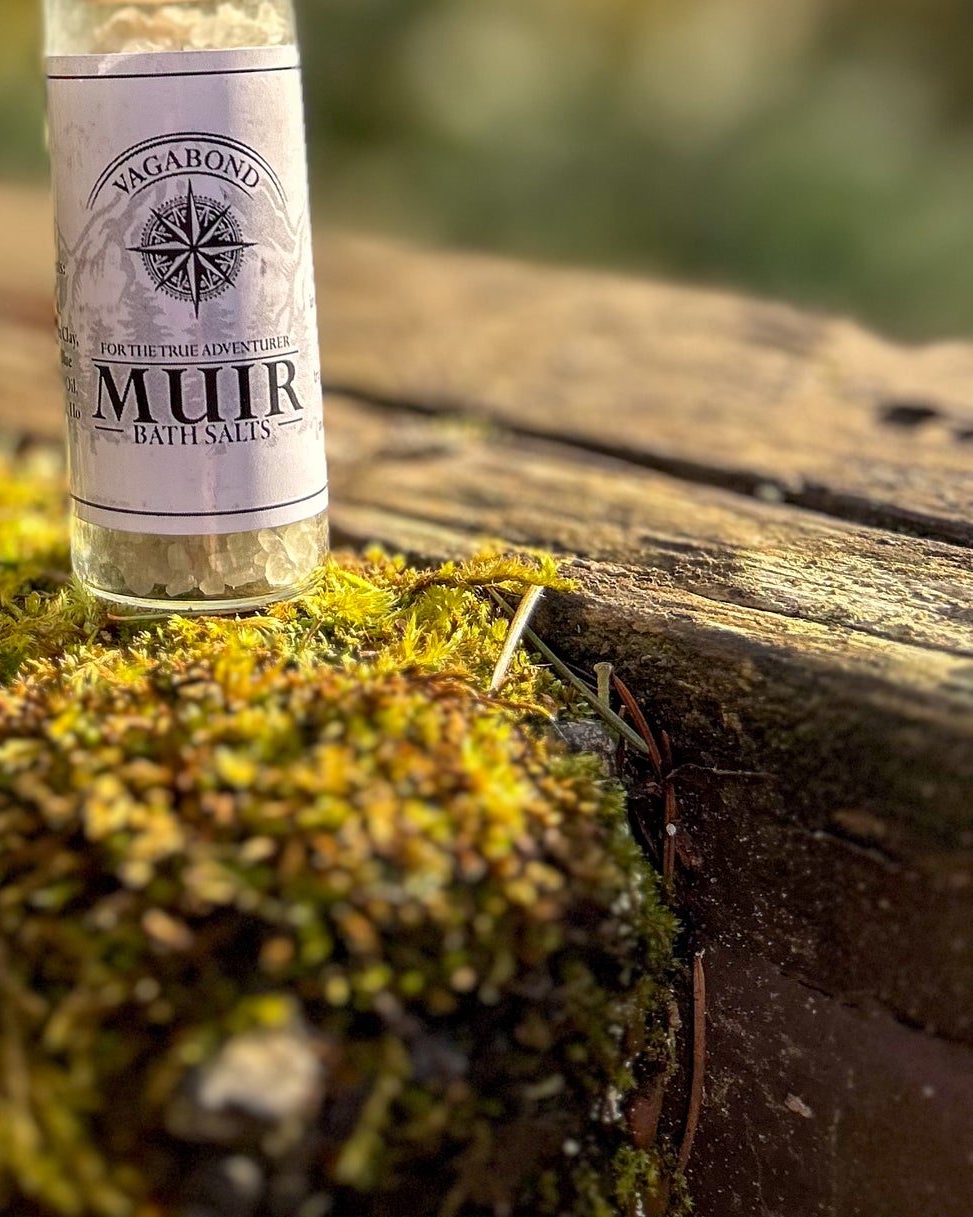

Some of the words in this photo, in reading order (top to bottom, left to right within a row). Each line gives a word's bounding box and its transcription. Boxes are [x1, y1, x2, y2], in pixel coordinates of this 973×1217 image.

[112, 147, 260, 195] VAGABOND
[101, 341, 126, 357] FOR
[127, 344, 155, 358] THE
[156, 343, 199, 358] TRUE
[202, 335, 291, 357] ADVENTURER
[91, 359, 304, 425] MUIR
[133, 424, 198, 446] BATH
[204, 419, 271, 445] SALTS
